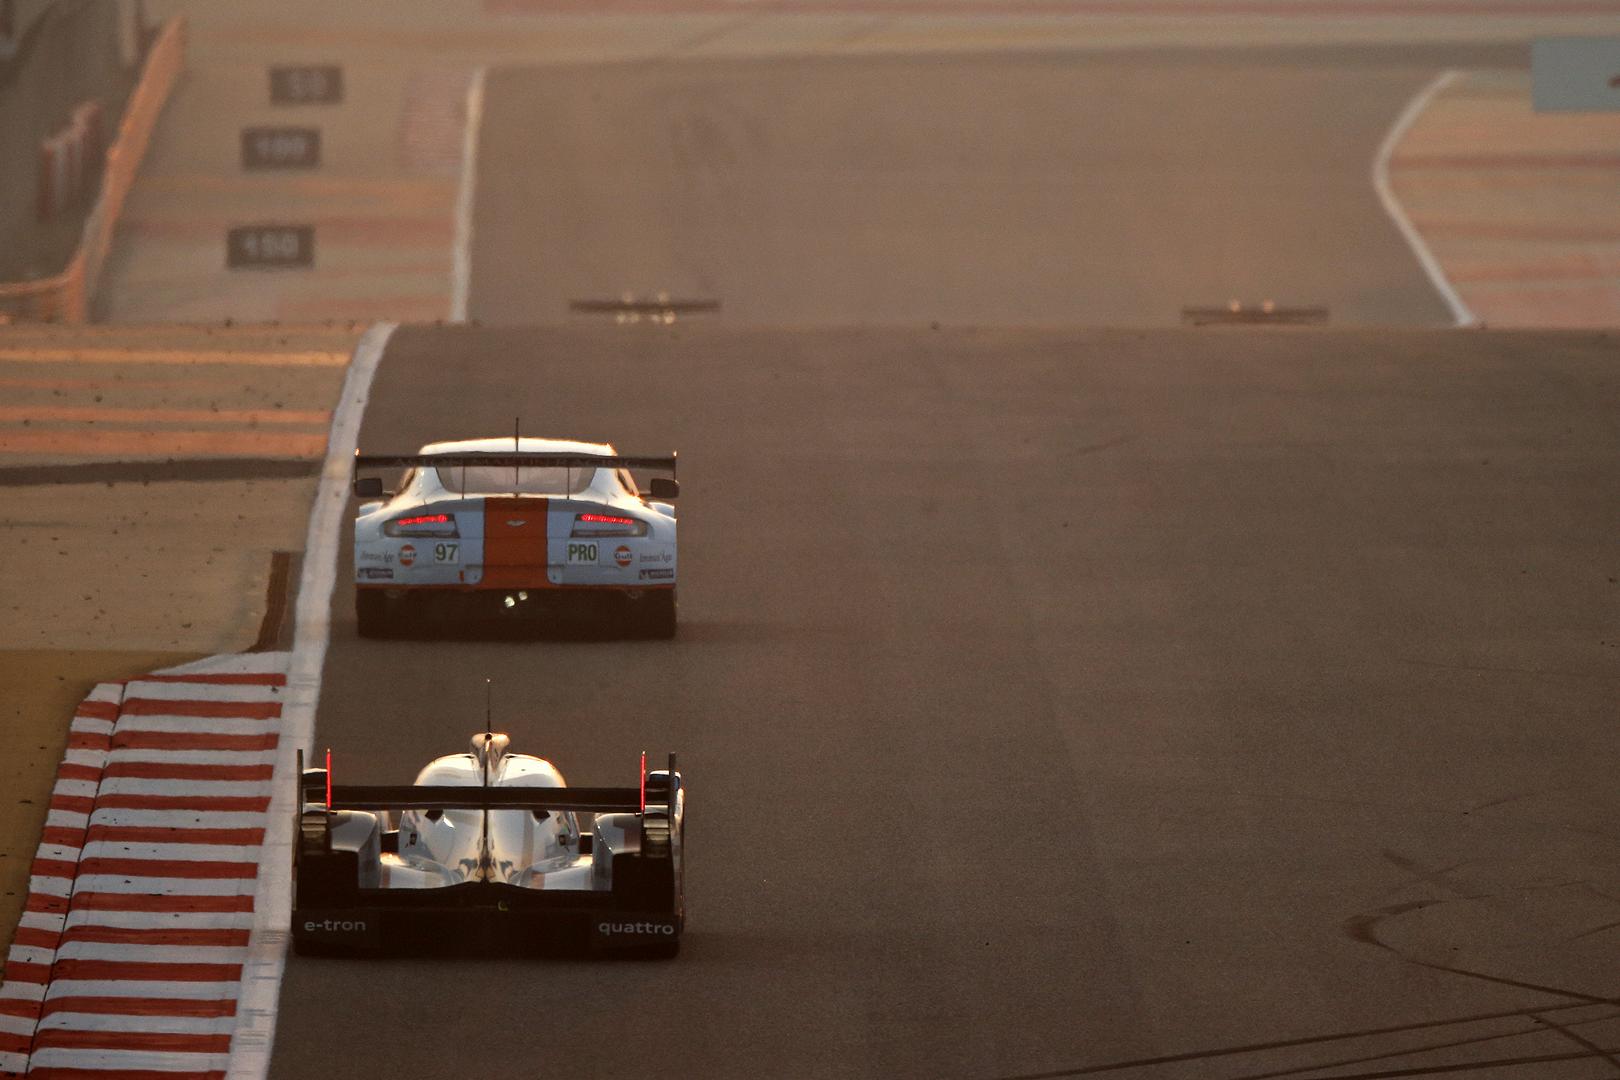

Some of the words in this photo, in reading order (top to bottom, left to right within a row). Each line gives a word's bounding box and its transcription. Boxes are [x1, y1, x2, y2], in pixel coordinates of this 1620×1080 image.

[435, 544, 458, 561] 97
[568, 544, 597, 561] PRO
[304, 920, 366, 931] e-tron
[599, 922, 674, 936] quattro
